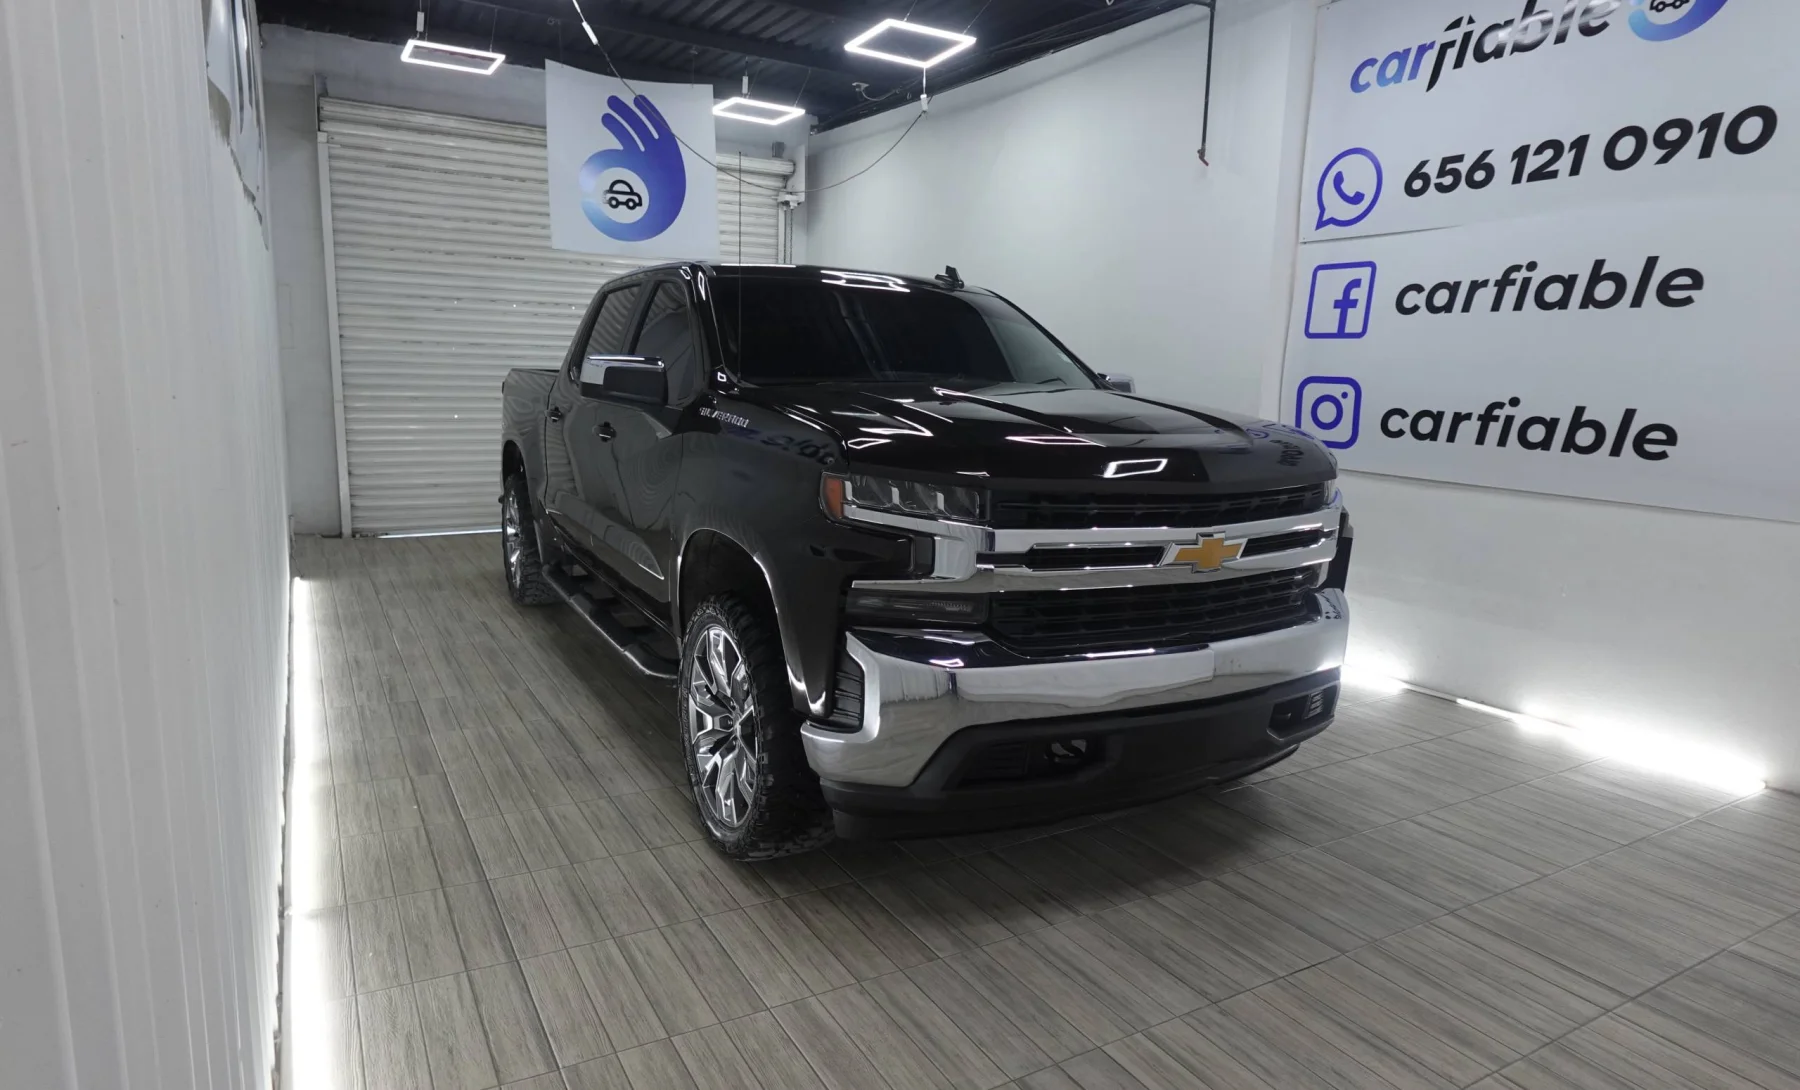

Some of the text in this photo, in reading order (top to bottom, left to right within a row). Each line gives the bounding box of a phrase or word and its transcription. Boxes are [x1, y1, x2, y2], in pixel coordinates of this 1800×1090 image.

[1350, 0, 1620, 93] carfiable
[1404, 105, 1777, 198] 656 121 0910
[1395, 256, 1704, 316] carfiable
[1380, 397, 1678, 461] carfiable
